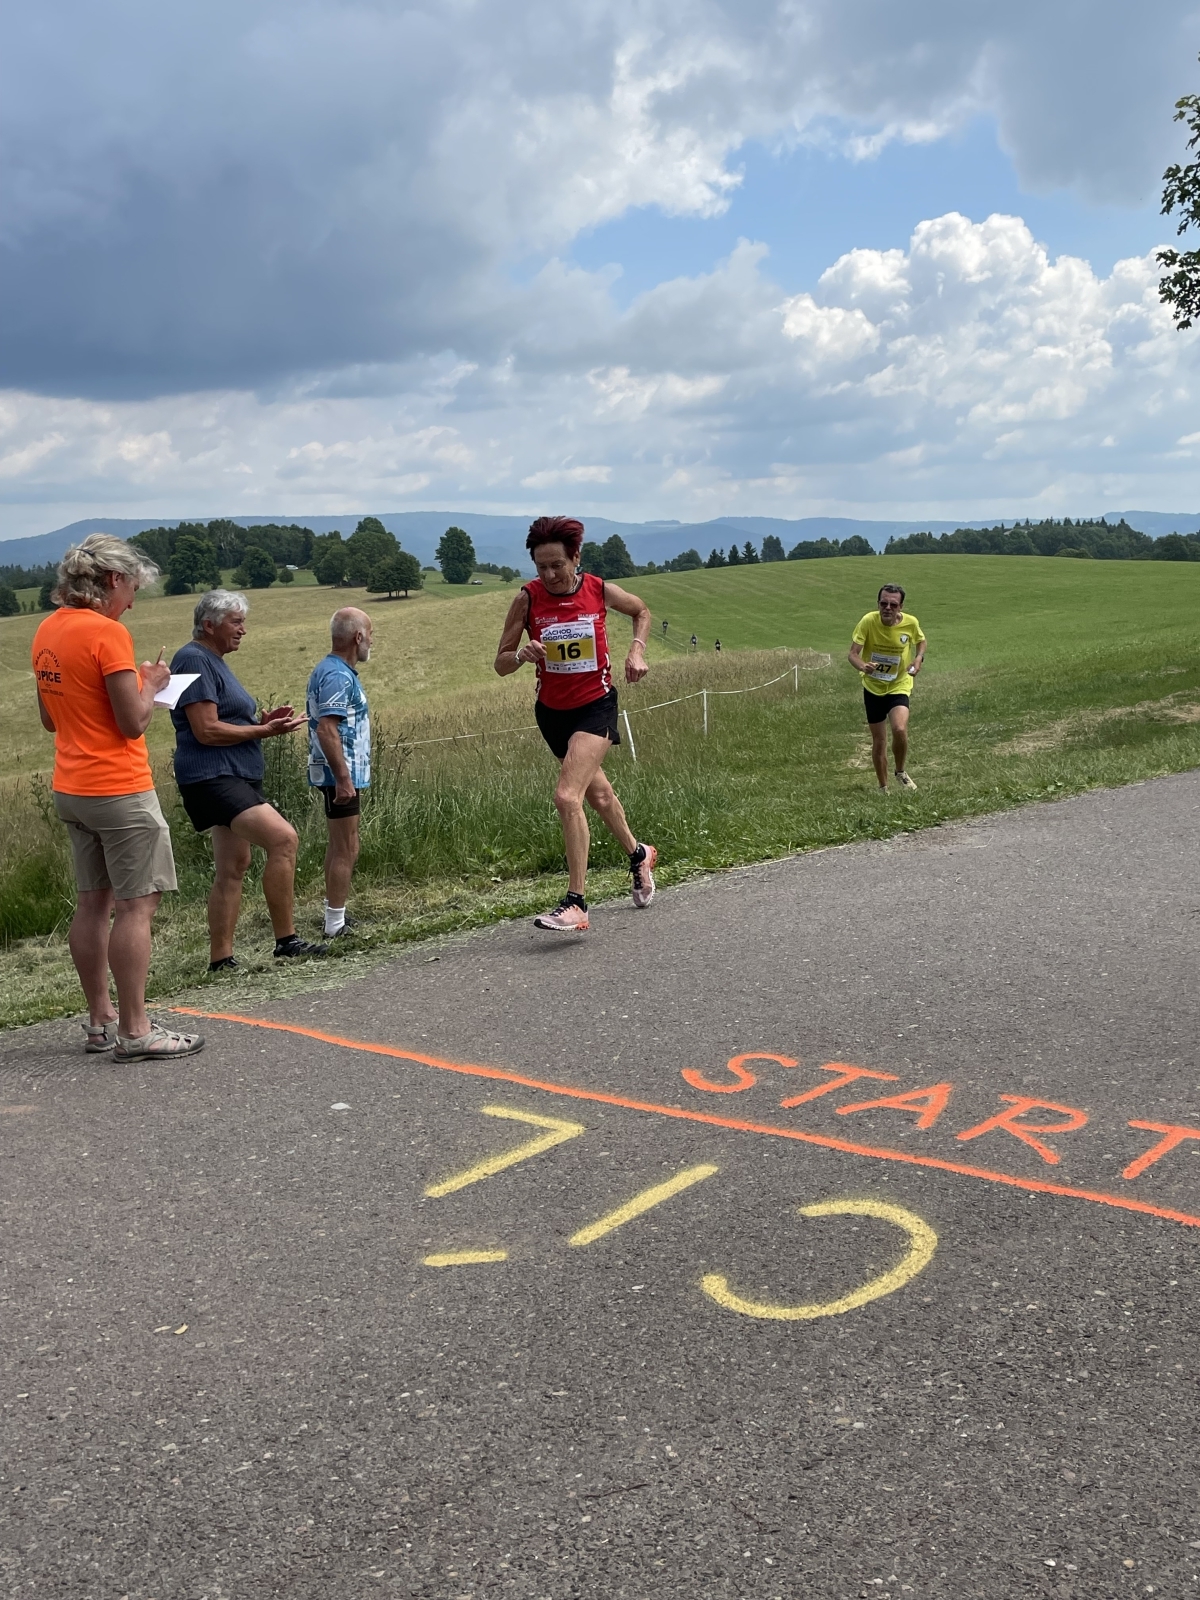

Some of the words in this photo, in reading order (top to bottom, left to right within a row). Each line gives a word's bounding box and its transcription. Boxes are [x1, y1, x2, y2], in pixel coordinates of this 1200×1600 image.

[557, 642, 581, 661] 16
[876, 664, 891, 673] 47
[681, 1052, 1200, 1180] START
